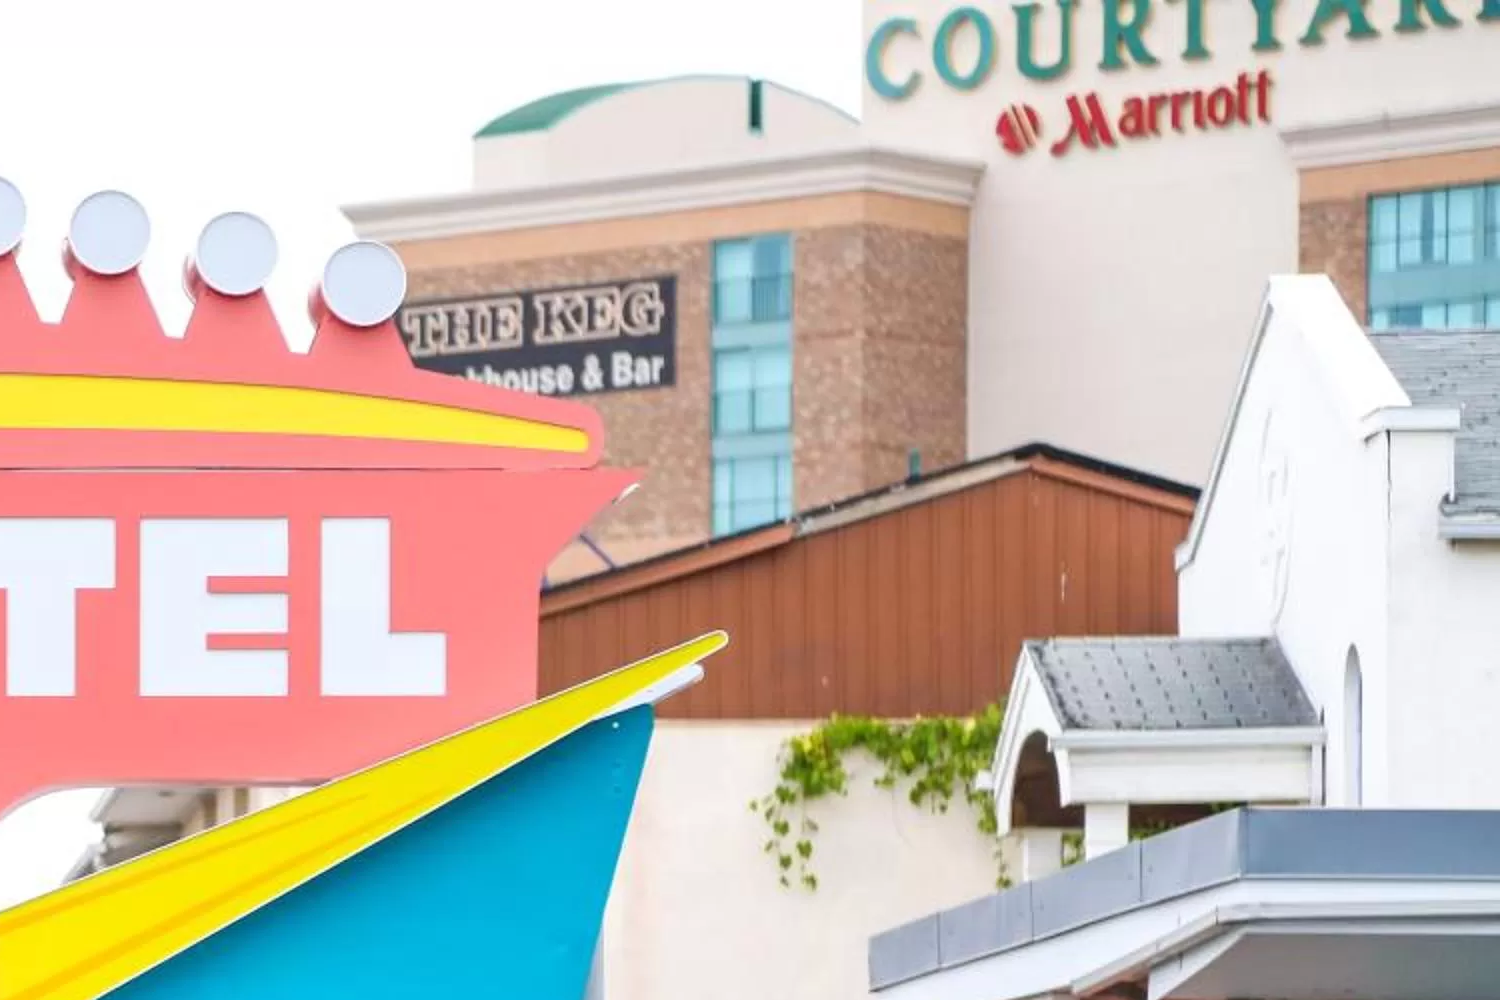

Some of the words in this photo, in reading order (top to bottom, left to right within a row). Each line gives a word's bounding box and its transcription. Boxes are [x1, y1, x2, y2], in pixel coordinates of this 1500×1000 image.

[1050, 69, 1274, 156] Marriott
[403, 297, 522, 357] THE
[532, 281, 666, 345] KEG
[581, 353, 604, 391] &
[611, 350, 665, 387] Bar
